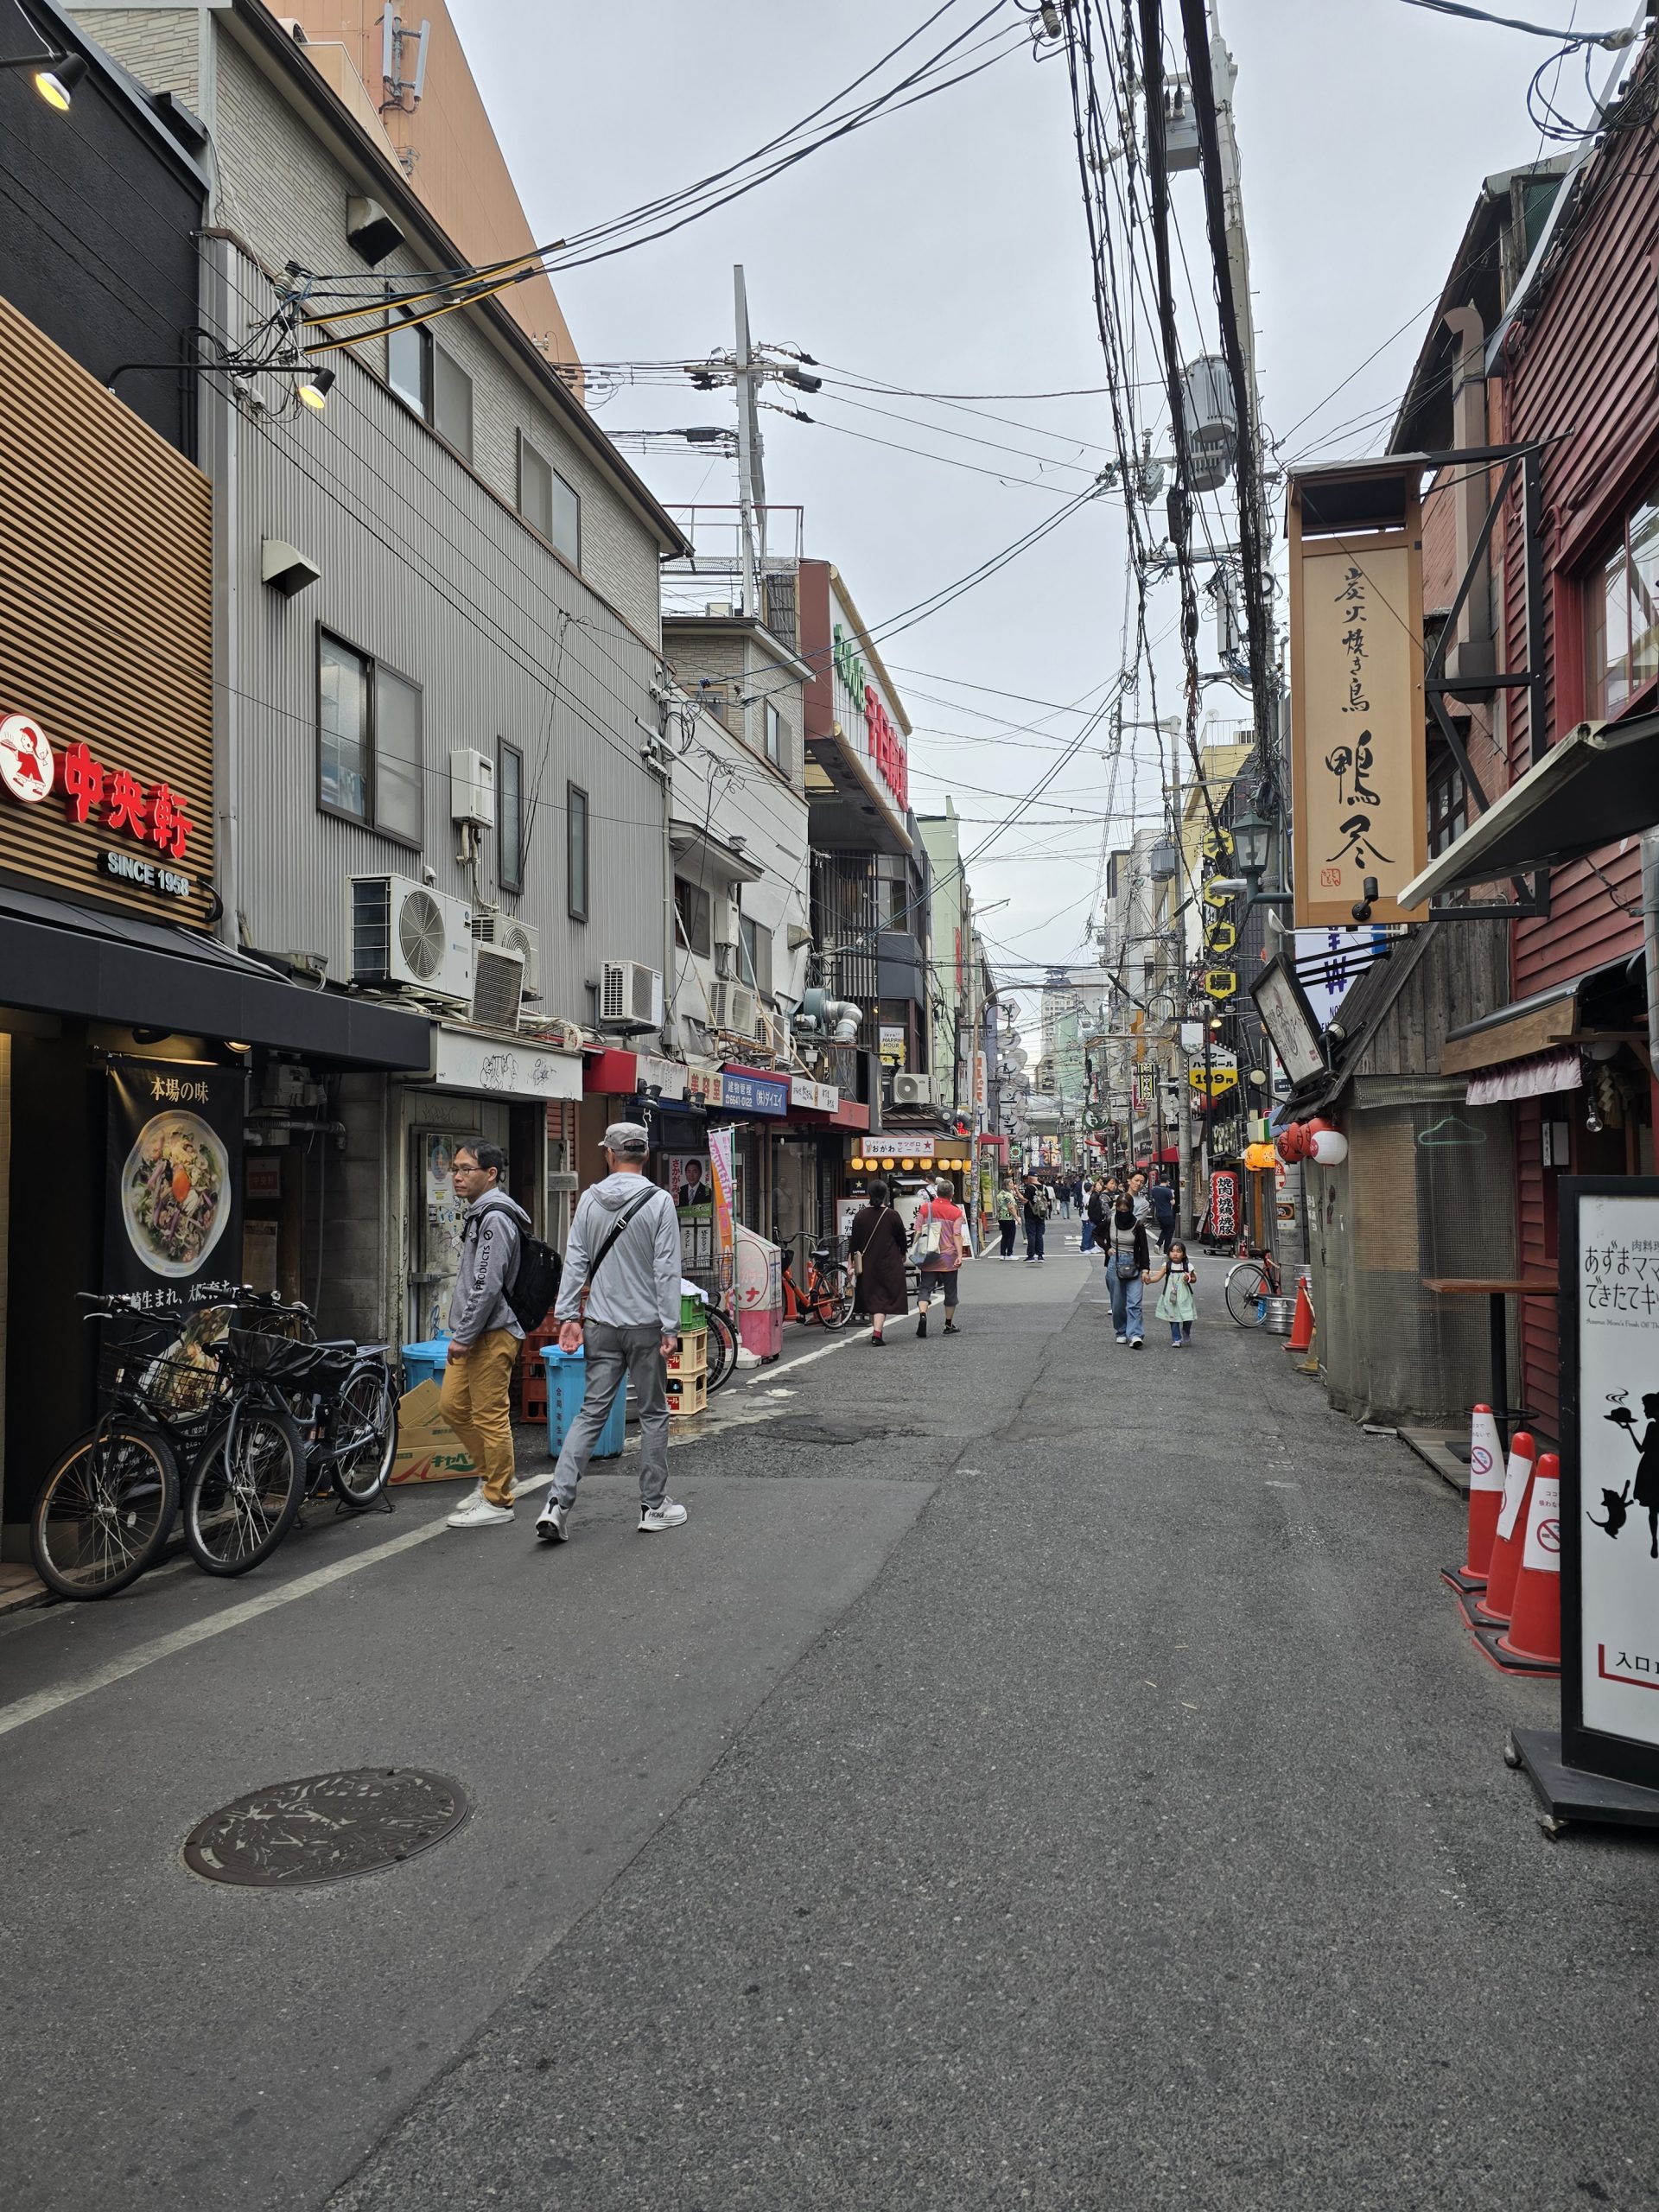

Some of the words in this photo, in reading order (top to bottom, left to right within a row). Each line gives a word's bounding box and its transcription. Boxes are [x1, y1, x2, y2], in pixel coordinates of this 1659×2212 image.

[63, 741, 194, 860] 中央軒
[106, 851, 156, 887] SINCE
[157, 869, 190, 897] 1958
[1206, 836, 1233, 991] 大酒場
[149, 1076, 209, 1104] 本場の味
[1217, 1176, 1235, 1196] 焼肉
[1217, 1216, 1236, 1236] 焼豚
[475, 1245, 491, 1291] PRODUCTS
[1586, 1275, 1659, 1315] できたてキ
[430, 1452, 471, 1467] キャベ
[1539, 1499, 1560, 1508] 吸わな
